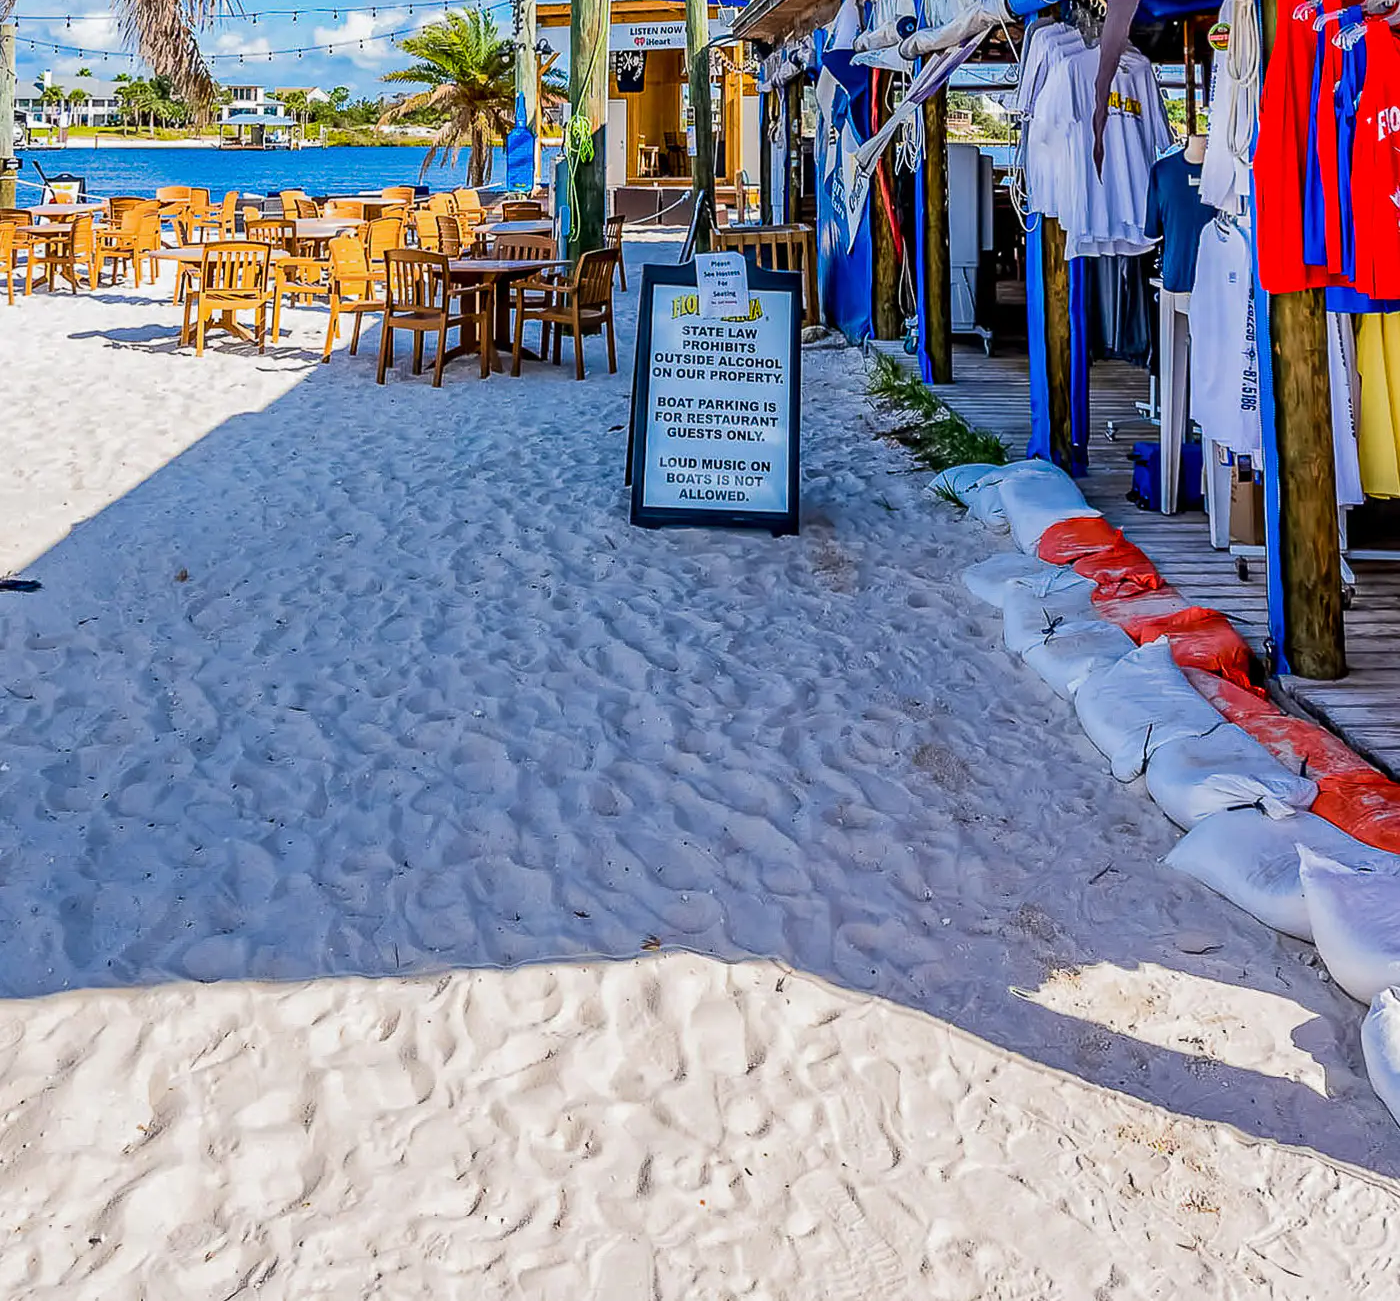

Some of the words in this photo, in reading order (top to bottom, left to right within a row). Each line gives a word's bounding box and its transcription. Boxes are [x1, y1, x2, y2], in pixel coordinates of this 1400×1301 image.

[629, 27, 659, 36] LISTEN
[660, 26, 683, 35] NOW
[682, 325, 725, 338] STATE
[728, 328, 758, 339] LAW
[682, 340, 756, 354] PROHIBITS
[654, 353, 715, 366] OUTSIDE
[718, 356, 783, 369] ALCOHOL
[652, 367, 672, 377] ON
[676, 368, 706, 380] OUR
[710, 370, 784, 384] PROPERTY.
[657, 397, 694, 408] BOAT
[698, 399, 759, 412] PARKING
[763, 402, 777, 413] IS
[655, 412, 683, 423] FOR
[686, 413, 779, 427] RESTAURANT
[667, 427, 723, 440] GUESTS
[727, 430, 765, 442] ONLY.
[659, 457, 697, 469] LOUD
[701, 459, 747, 471] MUSIC
[750, 461, 771, 472] ON
[666, 473, 712, 485] BOATS
[717, 474, 730, 486] IS
[734, 476, 764, 487] NOT
[678, 489, 750, 502] ALLOWED.
